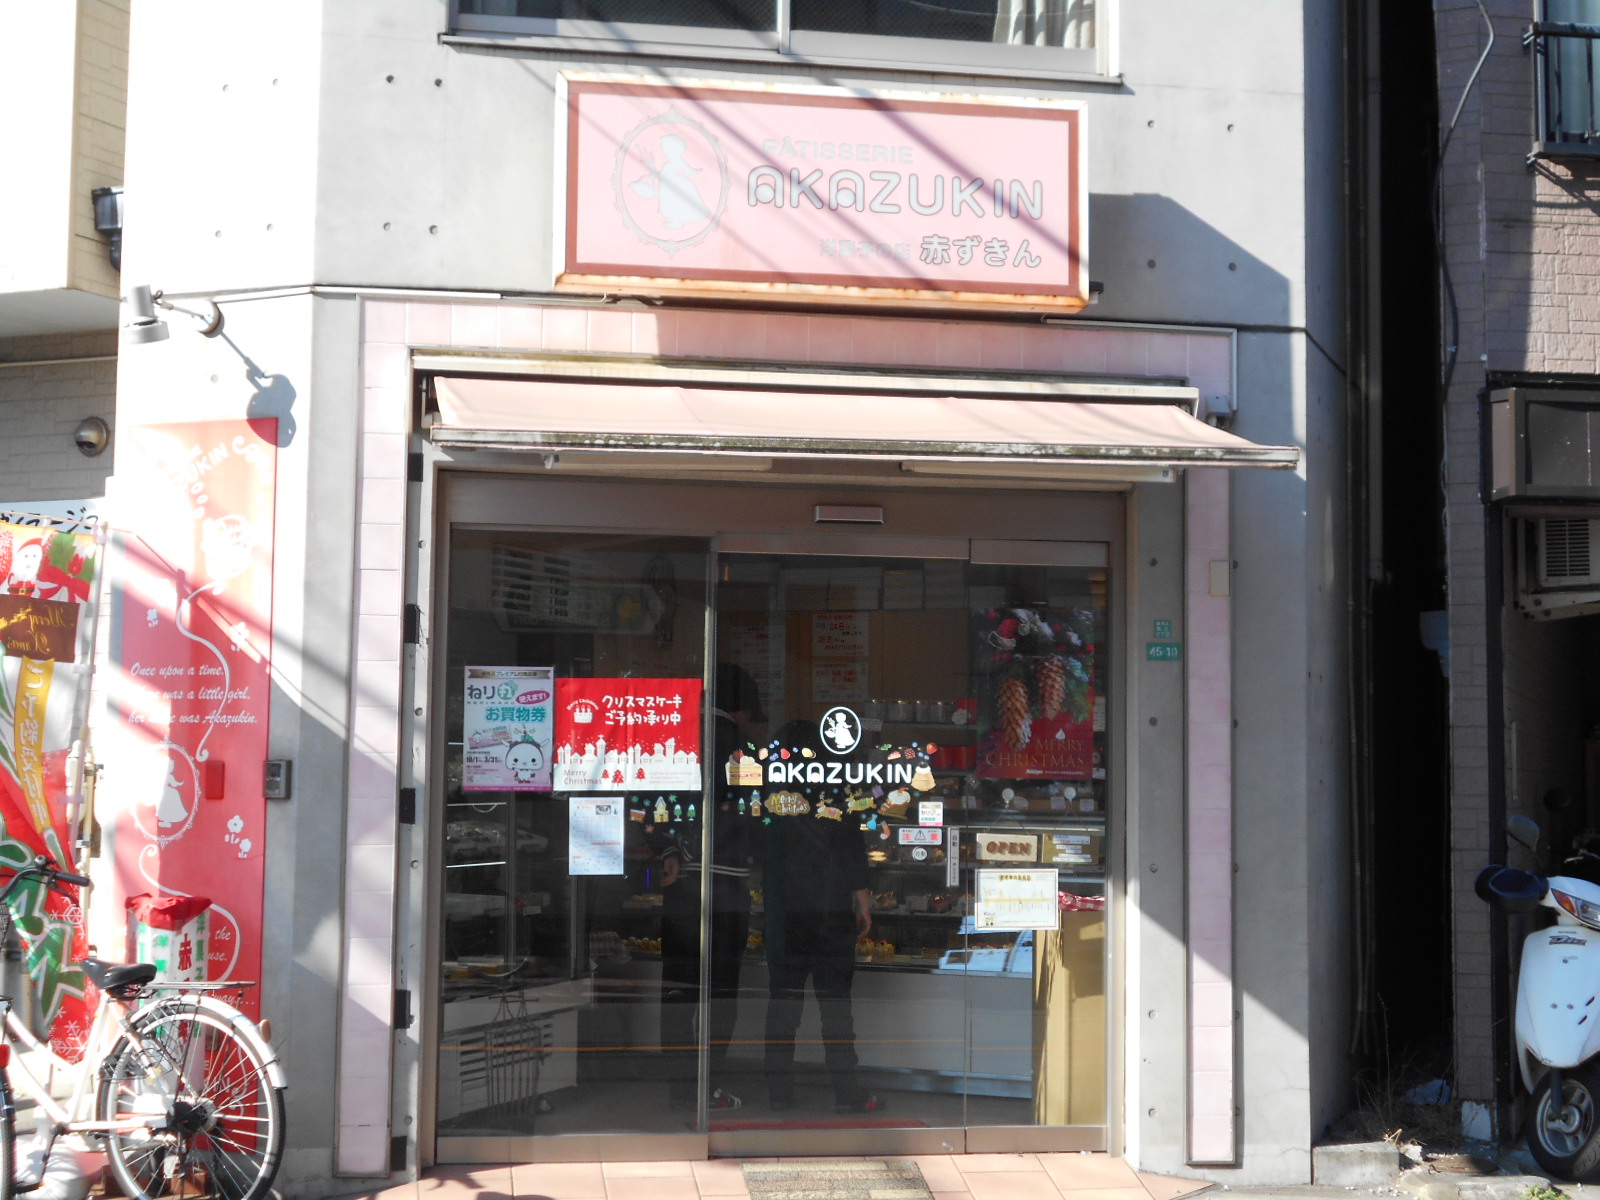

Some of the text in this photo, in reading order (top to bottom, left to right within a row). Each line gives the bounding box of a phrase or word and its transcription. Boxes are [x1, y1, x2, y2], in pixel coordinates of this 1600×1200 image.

[762, 136, 914, 165] PÂTISSERIE
[747, 164, 1043, 221] AKAZUKIN
[919, 233, 1042, 269] 赤ずきん
[130, 661, 156, 677] Once
[159, 664, 185, 679] upon
[187, 667, 196, 676] a
[163, 690, 184, 700] was
[187, 691, 195, 700] a
[198, 686, 225, 700] little
[602, 694, 683, 709] クリスマスケーキ
[179, 714, 201, 724] was
[485, 706, 546, 723] お買物券
[605, 709, 682, 726] ご予約承り中
[1035, 738, 1085, 751] MERRY
[985, 751, 1085, 768] CHRISTMAS
[563, 777, 602, 785] Christmas
[564, 769, 588, 777] Merry
[768, 762, 912, 784] AKAZUKIN
[986, 841, 1033, 856] OPEN
[215, 926, 231, 941] the
